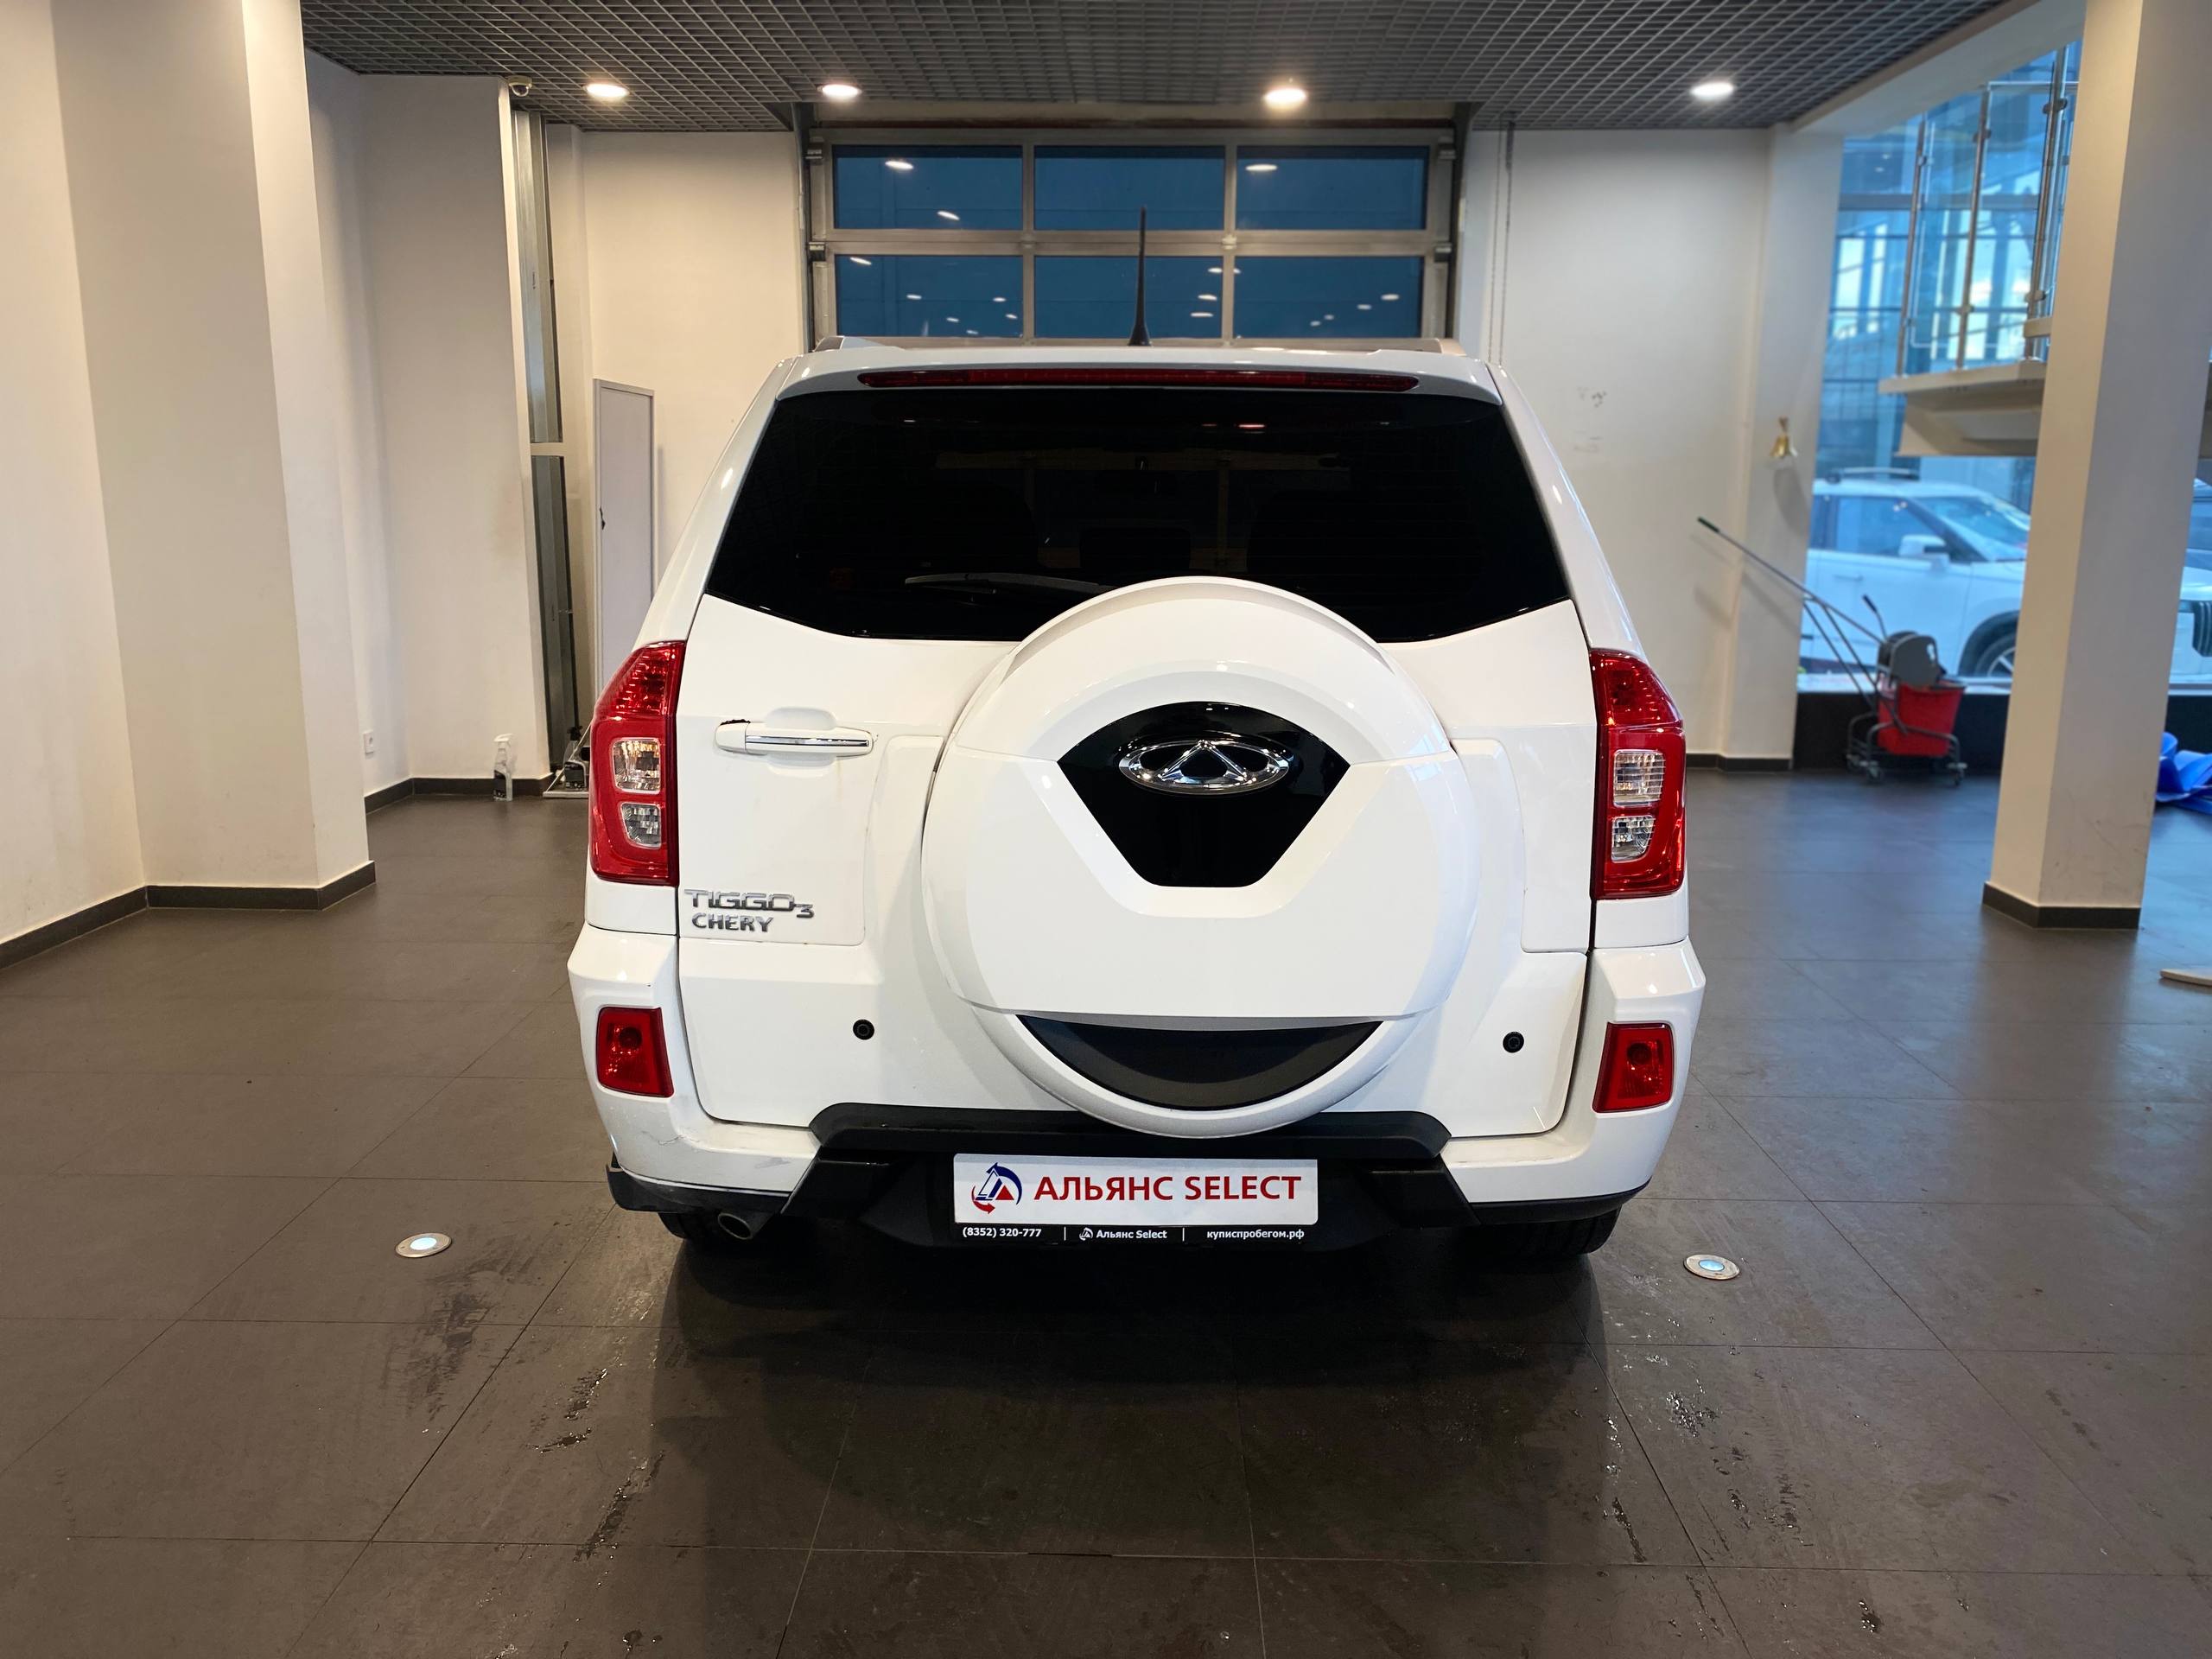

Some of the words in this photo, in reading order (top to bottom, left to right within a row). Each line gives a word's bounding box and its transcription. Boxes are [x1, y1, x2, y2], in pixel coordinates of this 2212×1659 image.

[691, 912, 774, 932] CHERY
[1033, 1176, 1173, 1201] АЛЬЯНС
[1185, 1176, 1301, 1200] SELECT
[962, 1227, 997, 1237] (8352)
[999, 1228, 1042, 1237] 320-777
[1096, 1229, 1134, 1239] Альянс
[1135, 1230, 1167, 1239] Select
[1206, 1229, 1305, 1241] куписпробегом.рф
